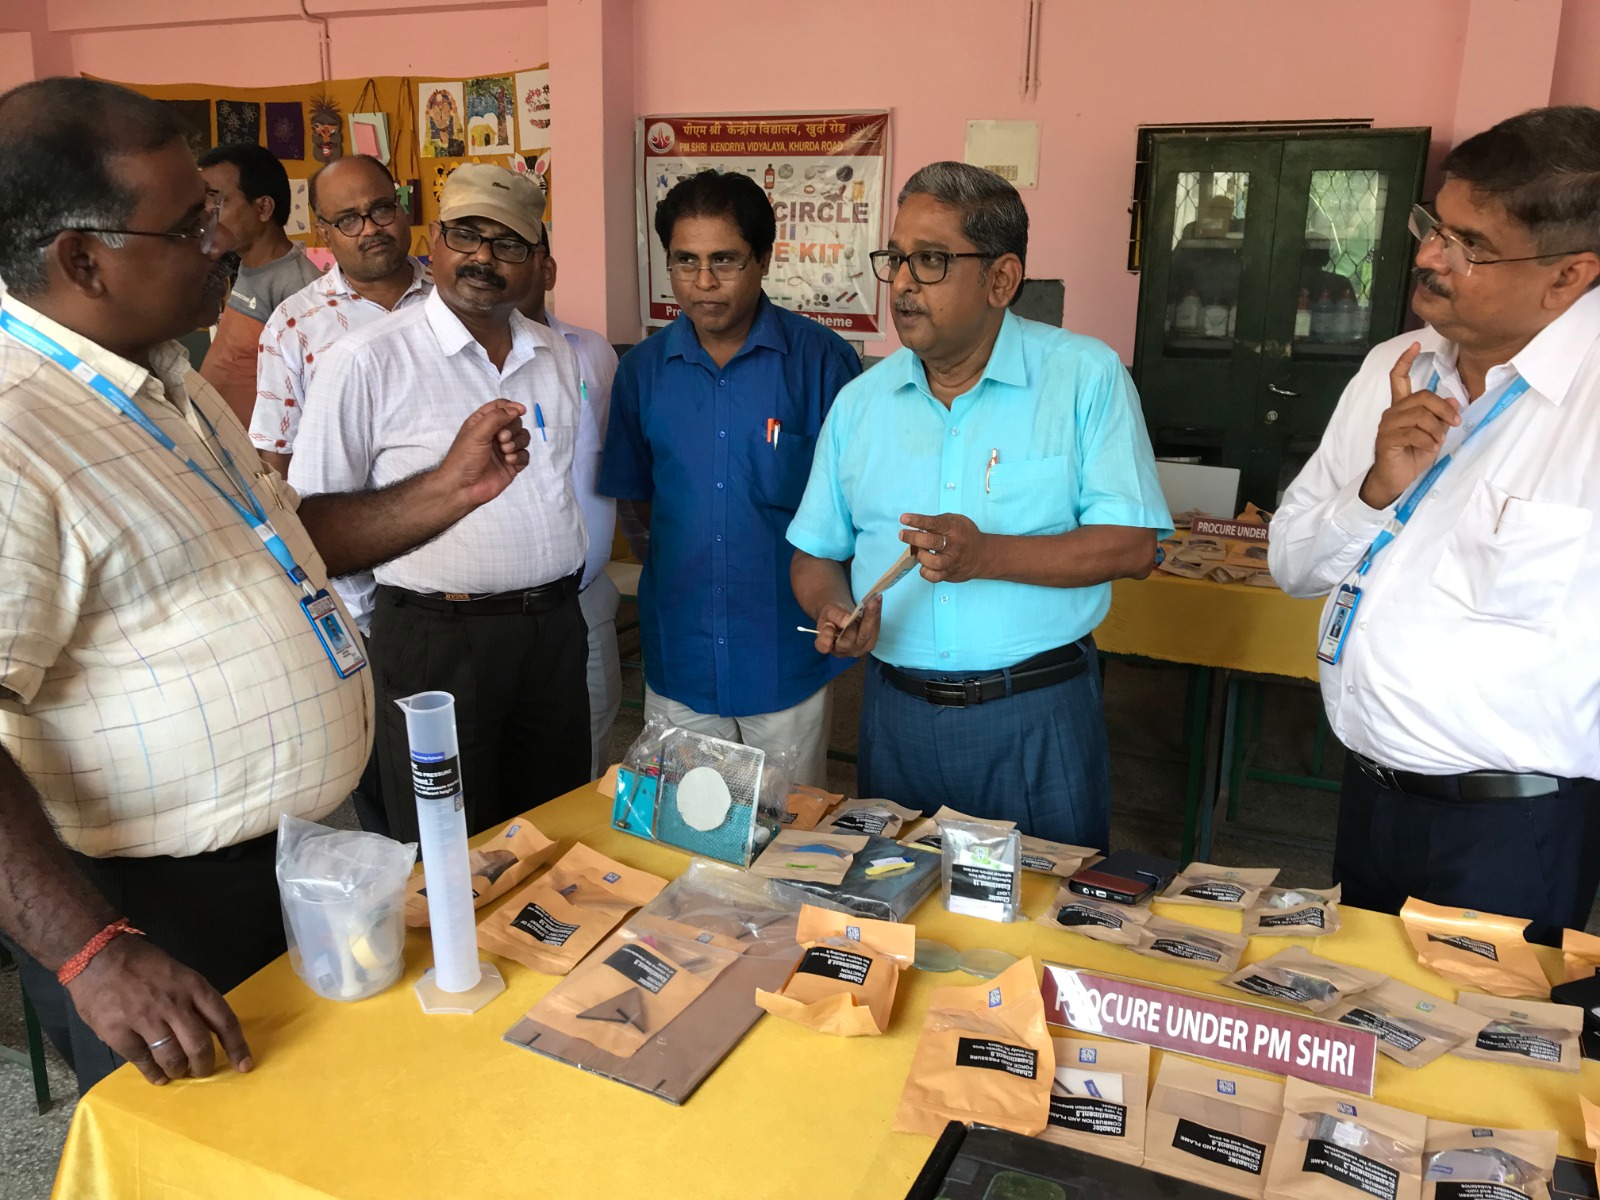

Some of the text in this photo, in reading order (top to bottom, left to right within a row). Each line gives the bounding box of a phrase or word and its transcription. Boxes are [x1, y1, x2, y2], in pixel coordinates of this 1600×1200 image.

[829, 119, 846, 134] रोड
[680, 142, 690, 152] PM
[691, 142, 708, 152] SHRI
[710, 142, 745, 152] KENDRIYA
[789, 141, 820, 152] KHURDA
[821, 141, 844, 152] ROAD
[773, 201, 869, 223] CIRCLE
[799, 242, 845, 265] KIT
[802, 313, 853, 328] heme
[1197, 521, 1267, 540] PROCURE UNDER
[841, 968, 865, 977] FRICTION
[1055, 983, 1162, 1033] OCURE
[1166, 1005, 1249, 1052] UNDER
[1253, 1024, 1291, 1062] PM
[1296, 1034, 1356, 1076] SHRI
[1049, 1111, 1067, 1119] FLAM
[1082, 1111, 1123, 1121] Experiment
[1082, 1118, 1122, 1126] COMBUSTION
[1093, 1125, 1122, 1134] Chapter
[1180, 1135, 1260, 1165] COMBUSTION AND FLAME
[1228, 1156, 1259, 1171] Chapter
[1310, 1158, 1395, 1194] COMBUSTION AND FLAME
